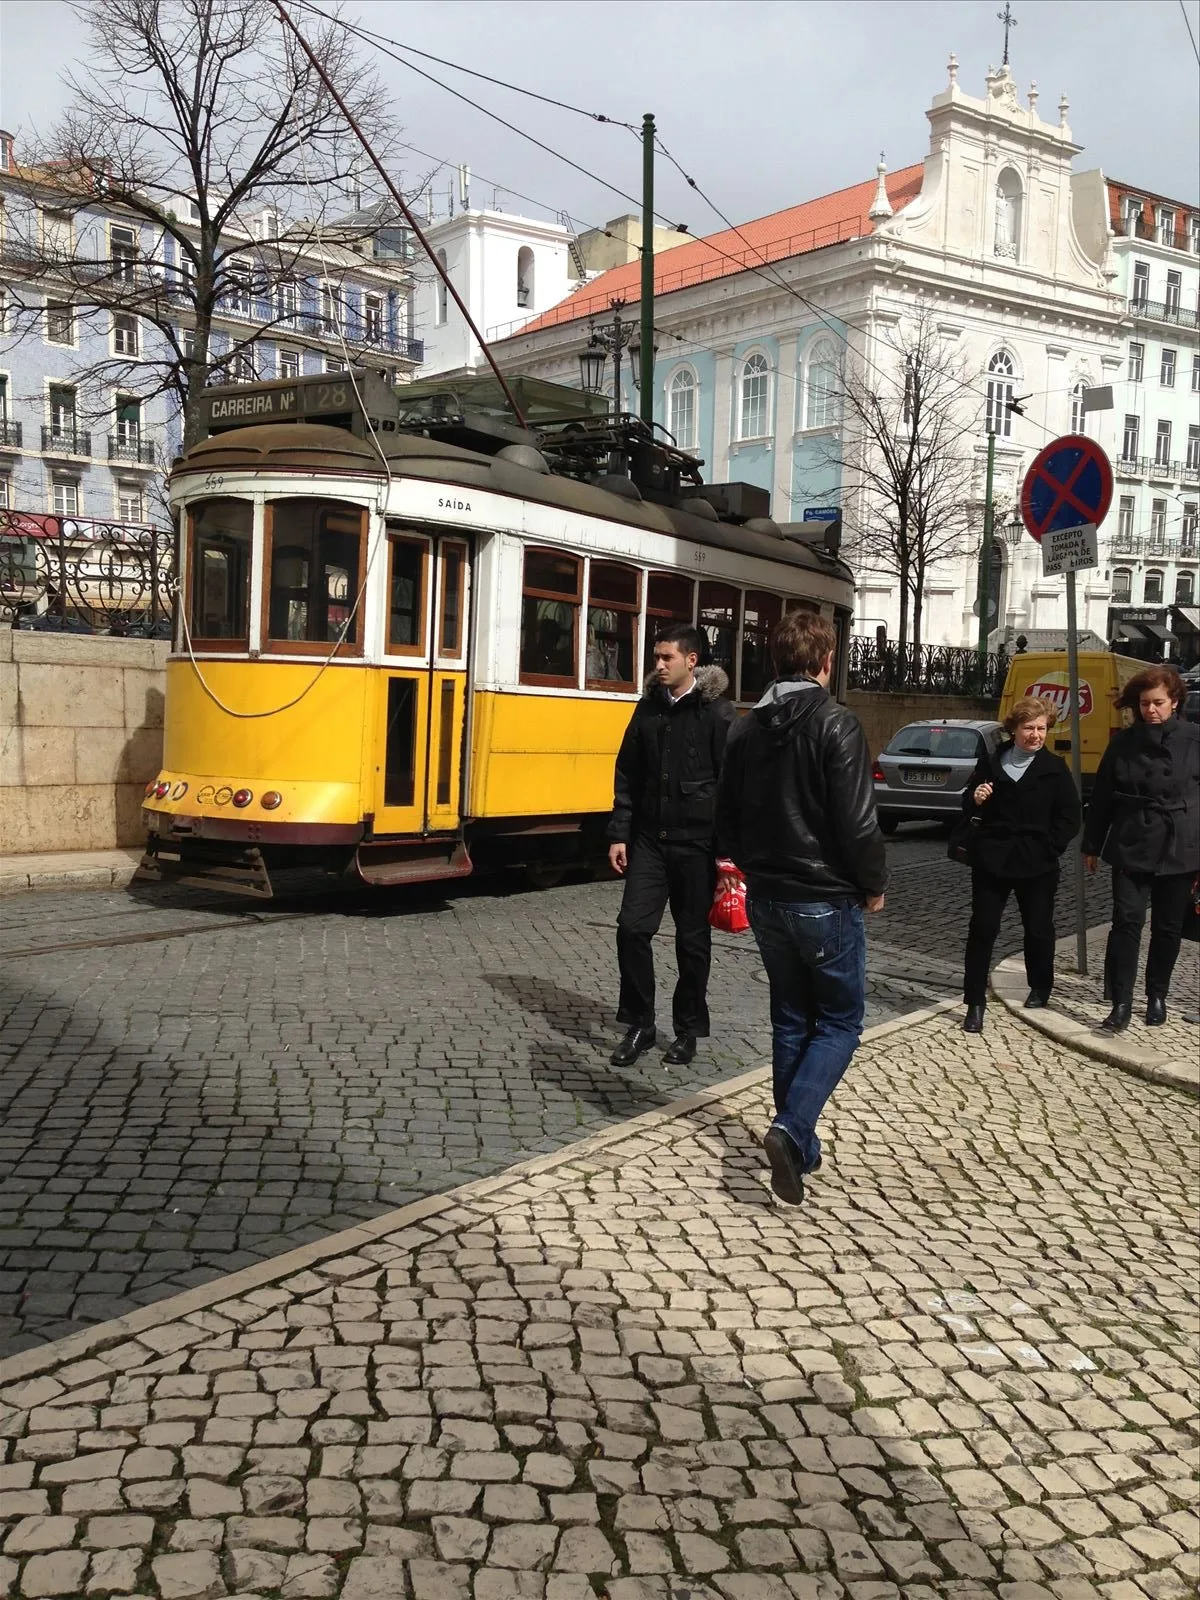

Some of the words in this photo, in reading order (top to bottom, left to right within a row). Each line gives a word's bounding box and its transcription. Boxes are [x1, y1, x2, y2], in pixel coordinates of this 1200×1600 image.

[212, 395, 272, 418] CARREIRA
[317, 384, 347, 409] 28
[205, 476, 224, 490] 559
[1052, 530, 1083, 542] EXCEPTO
[1051, 541, 1080, 552] TOMADA
[1081, 539, 1087, 547] E
[1080, 548, 1091, 556] DE
